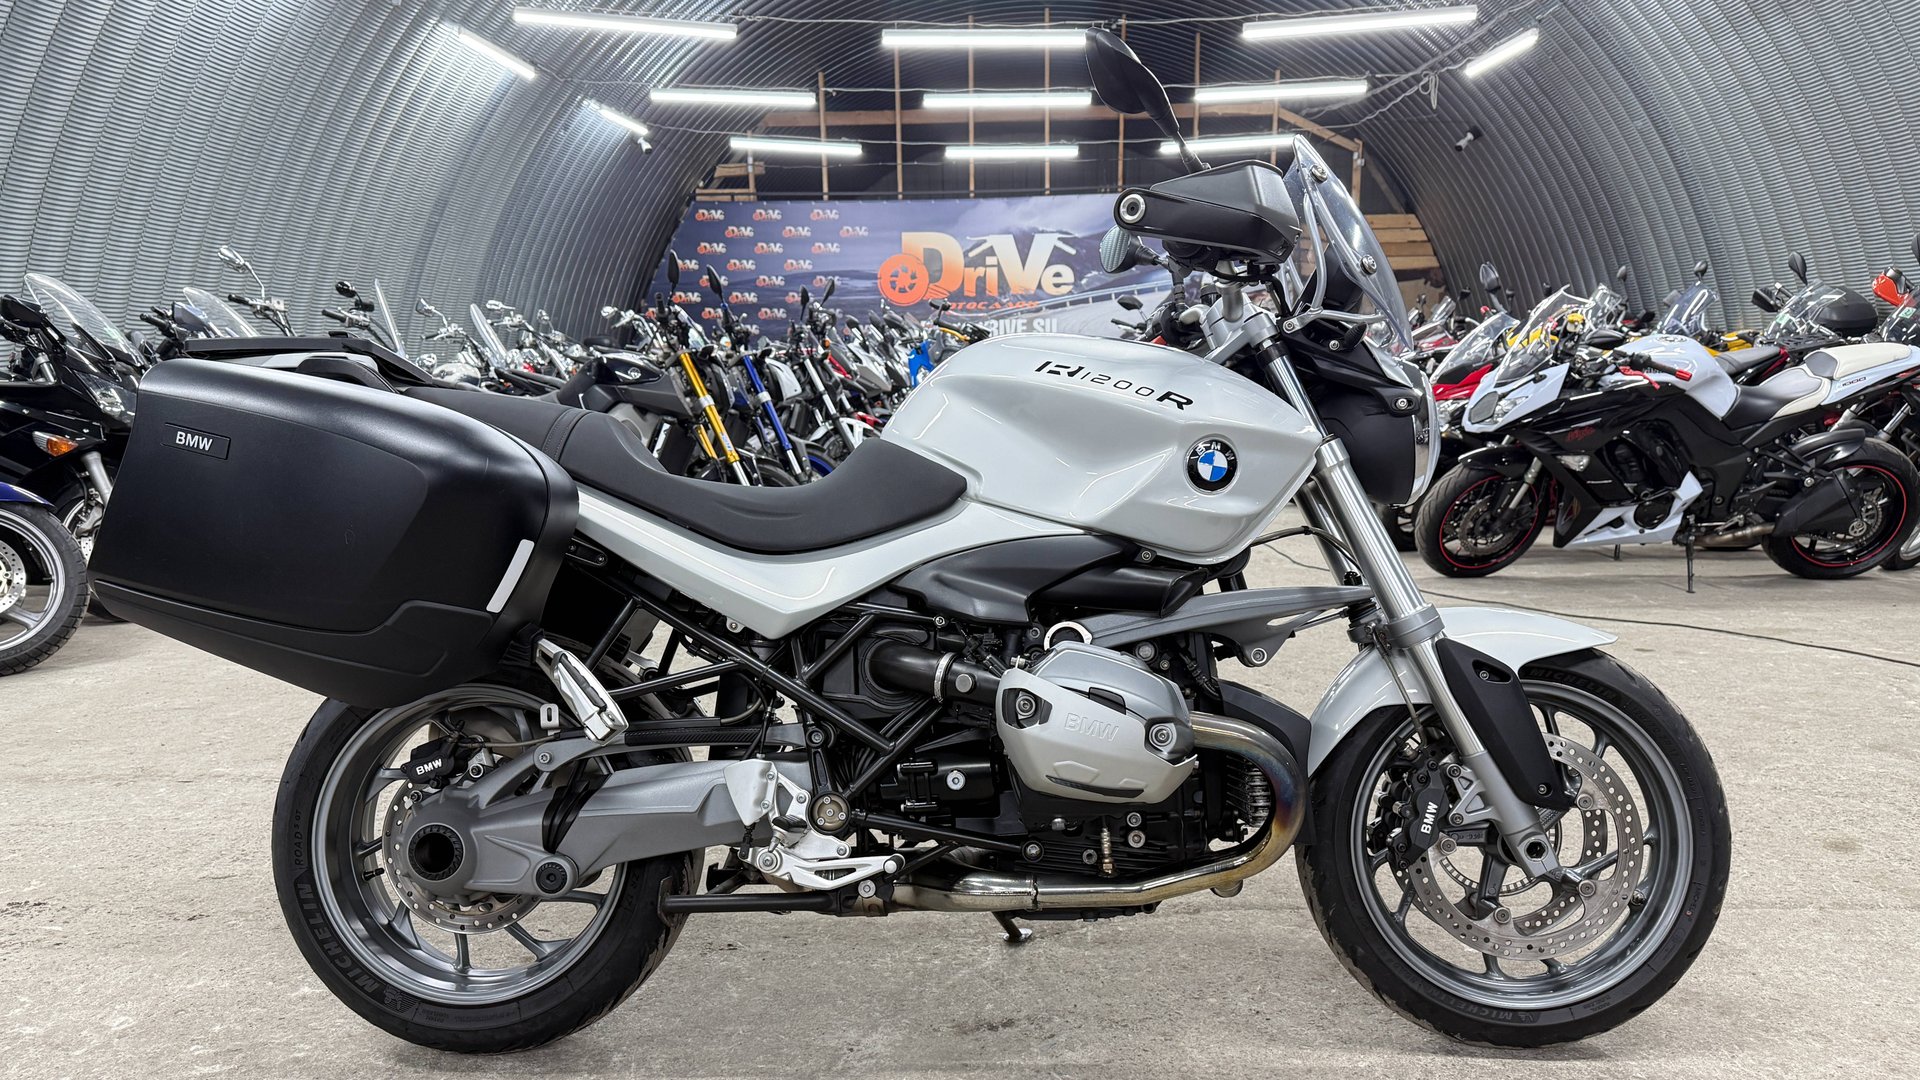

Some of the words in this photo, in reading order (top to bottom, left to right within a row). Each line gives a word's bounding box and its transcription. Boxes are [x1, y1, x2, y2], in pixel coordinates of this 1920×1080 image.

[175, 431, 213, 451] BMW
[1194, 441, 1235, 461] BMW
[1529, 667, 1619, 703] MICHELIN
[1064, 713, 1118, 742] BMW
[415, 758, 443, 776] BMW
[1420, 801, 1439, 835] BMW
[294, 831, 304, 866] ROAD
[295, 882, 381, 994] MICHELIN
